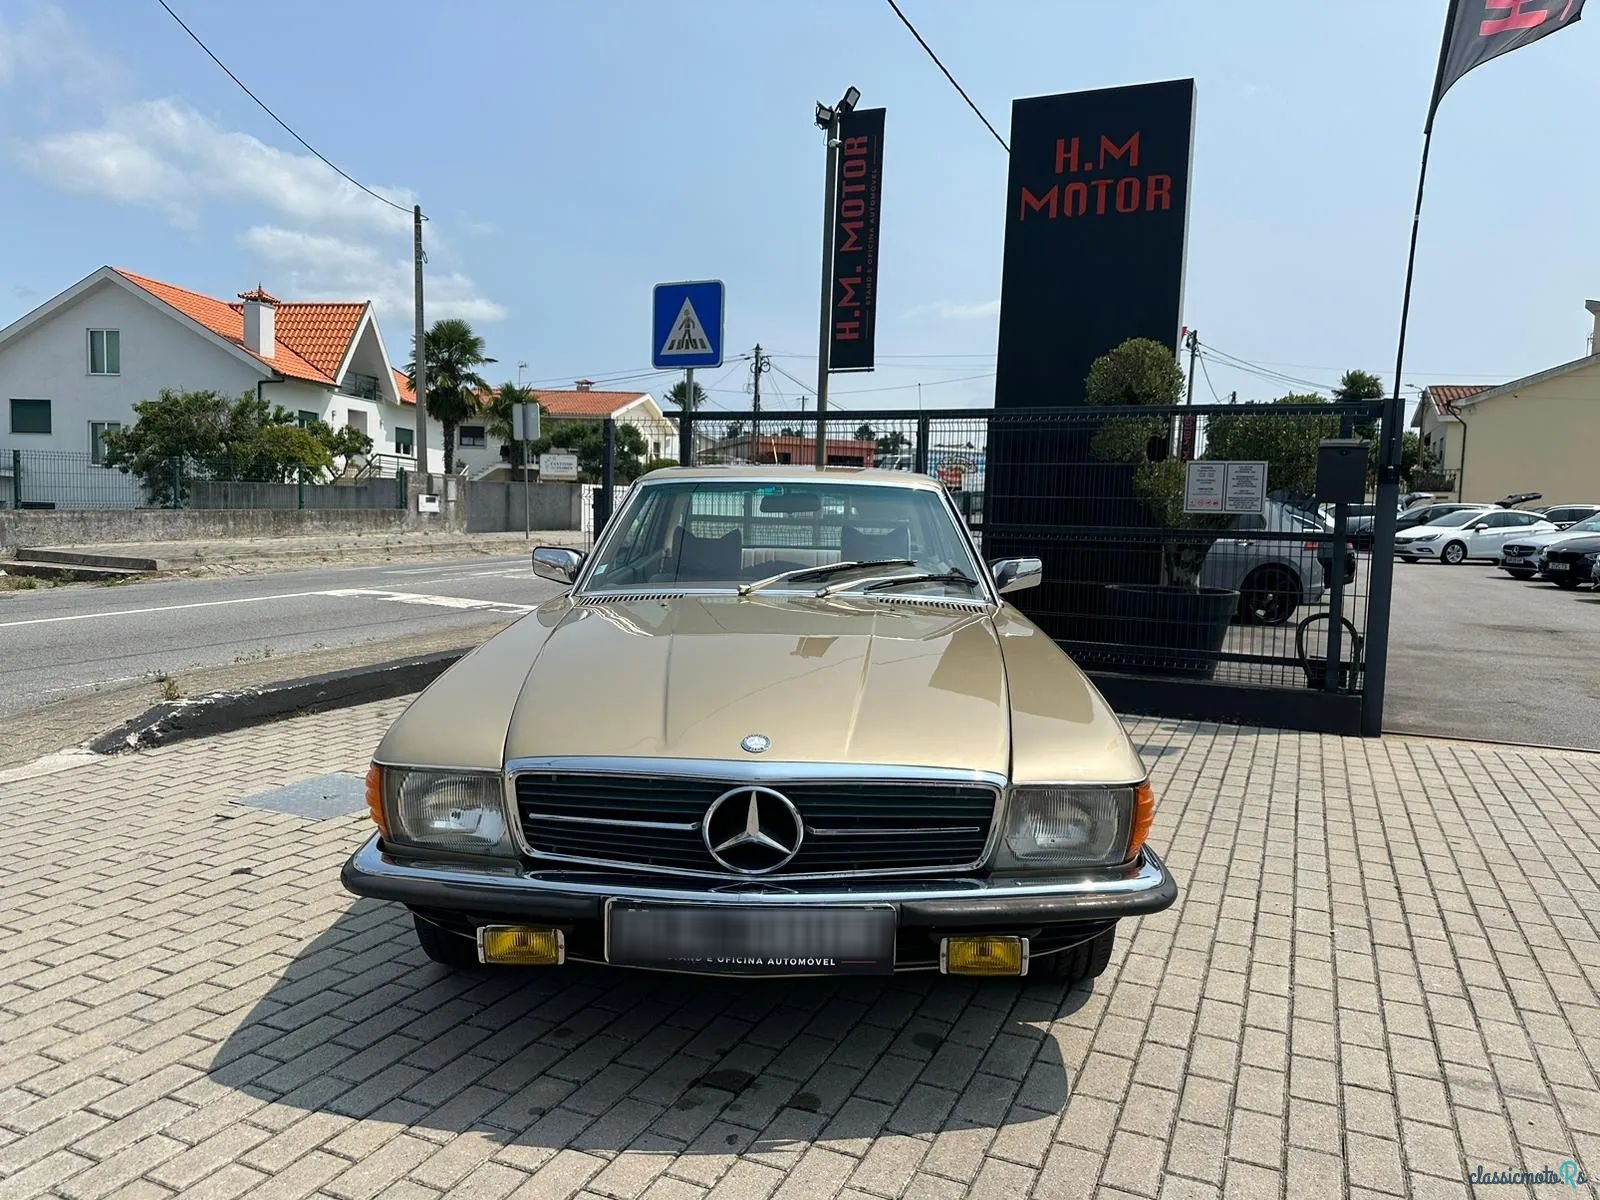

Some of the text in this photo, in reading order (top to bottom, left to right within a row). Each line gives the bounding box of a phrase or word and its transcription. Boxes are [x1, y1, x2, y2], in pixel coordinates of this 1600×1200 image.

[1055, 131, 1140, 173] H.M
[841, 135, 868, 251] MOTOR
[1019, 175, 1172, 222] MOTOR
[867, 227, 875, 265] OFICINA
[865, 276, 873, 305] STAND
[717, 957, 763, 965] OFICINA
[767, 956, 836, 966] AUTOMÓVEL
